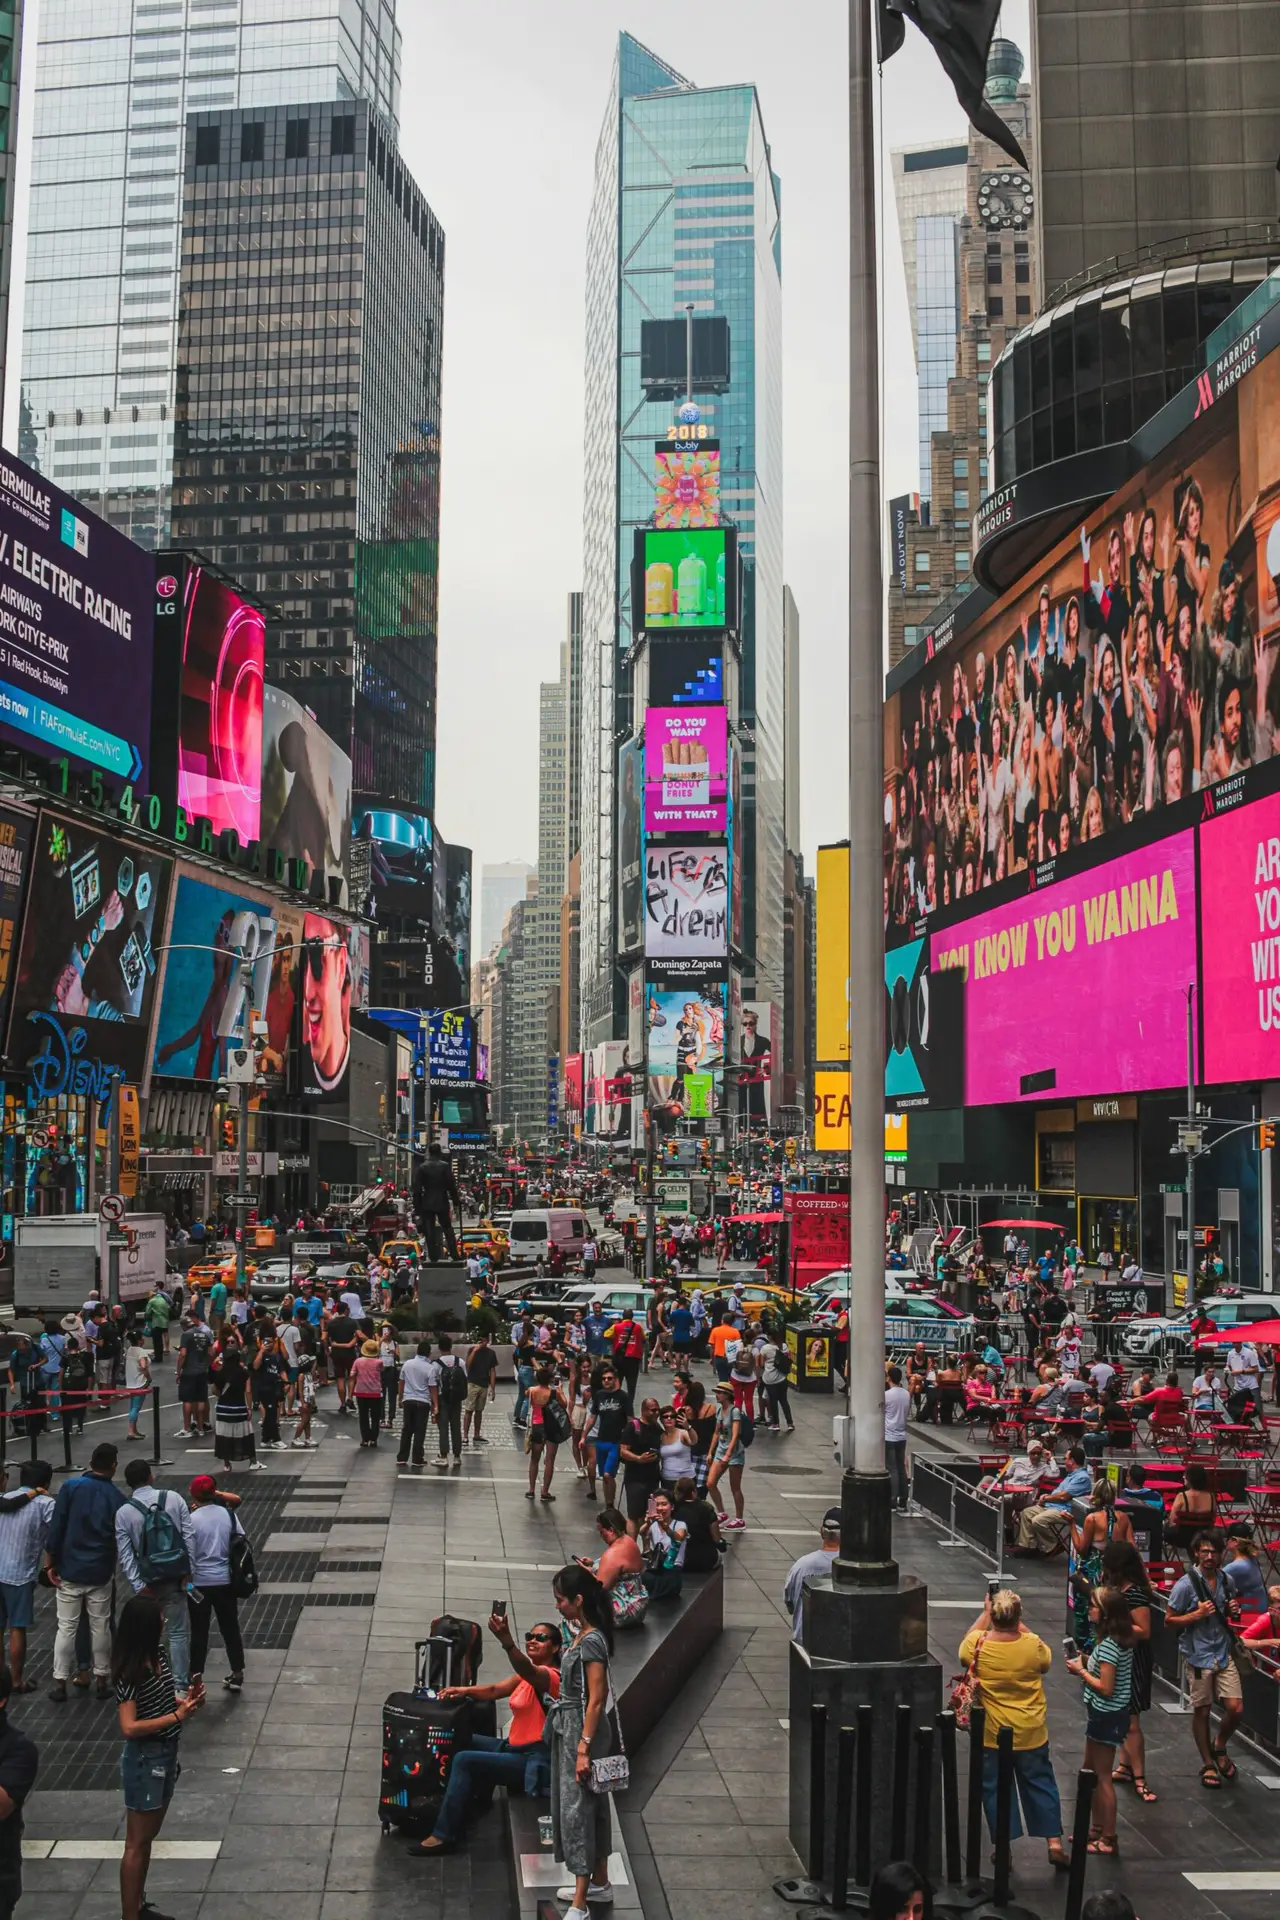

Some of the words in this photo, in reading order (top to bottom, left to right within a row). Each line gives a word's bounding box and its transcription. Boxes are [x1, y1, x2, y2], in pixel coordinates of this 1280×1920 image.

[1216, 325, 1261, 376] MARRIOTT
[1217, 350, 1257, 396] MARQUIS
[667, 424, 708, 440] 2018
[675, 441, 699, 451] bubly
[12, 501, 50, 531] CHAMPIONSHIP
[897, 510, 905, 539] NOW
[898, 543, 906, 568] OUT
[12, 539, 82, 611] ELECTRIC
[84, 585, 132, 641] RACING
[0, 584, 42, 622] AIRWAYS
[156, 603, 176, 615] LG
[934, 613, 956, 639] MARRIOTT
[18, 620, 39, 646] CITY
[40, 631, 69, 663] E-PRIX
[934, 629, 954, 652] MARQUIS
[12, 655, 25, 672] Red
[25, 660, 42, 683] Hook,
[43, 670, 68, 694] Brooklyn
[12, 699, 29, 718] now
[666, 719, 682, 727] DO
[685, 718, 707, 727] YOU
[670, 728, 702, 736] WANT
[667, 780, 701, 788] DONUT
[667, 789, 693, 797] FRIES
[1216, 776, 1246, 797] MARRIOTT
[1216, 791, 1243, 810] MARQUIS
[654, 811, 682, 820] WITH
[685, 810, 718, 819] THAT?
[58, 757, 161, 830] 1540
[175, 806, 343, 905] BROADW
[1036, 860, 1056, 875] MARRIOTT
[1036, 872, 1054, 885] MARQUIS
[974, 921, 1029, 980] KNOW
[1033, 904, 1076, 961] YOU
[1082, 869, 1179, 945] WANNA
[425, 944, 433, 985] 1500
[651, 960, 689, 972] Domingo
[691, 960, 722, 971] Zapata
[1093, 1101, 1119, 1117] INVICTA
[667, 1185, 687, 1193] CELTIC
[796, 1200, 837, 1209] COFFEED
